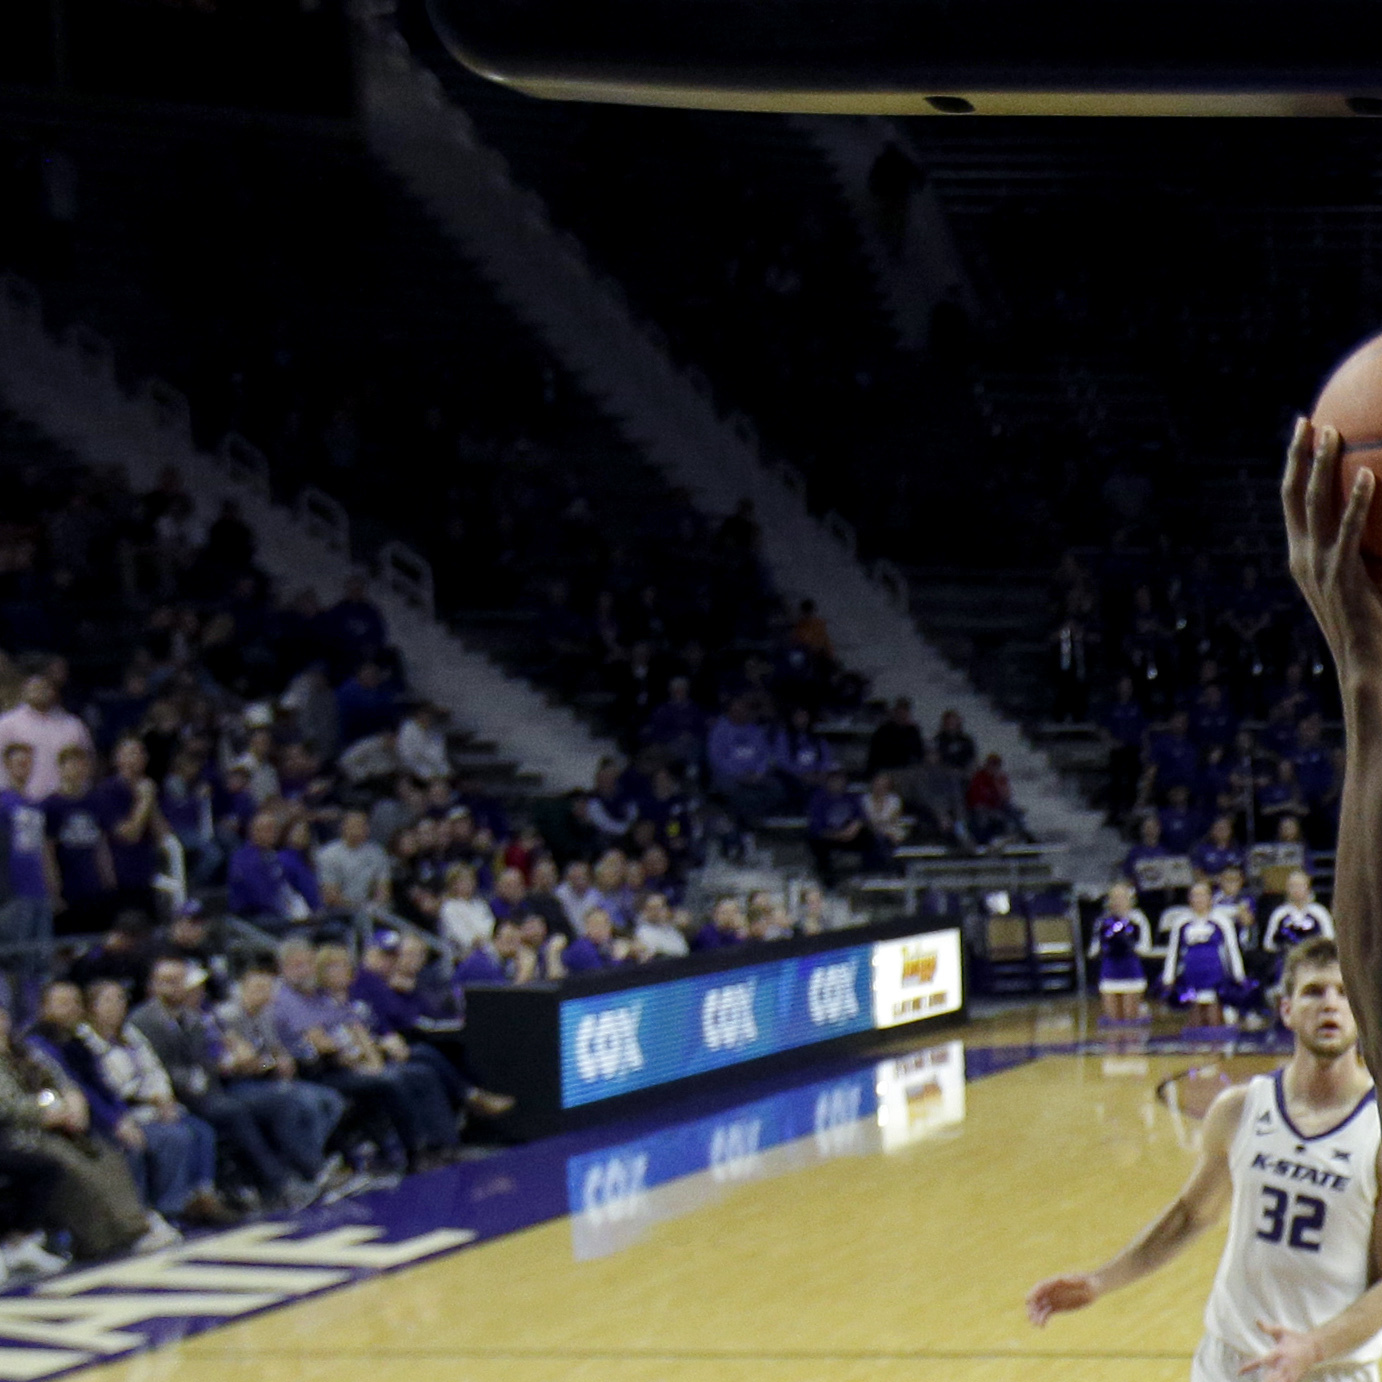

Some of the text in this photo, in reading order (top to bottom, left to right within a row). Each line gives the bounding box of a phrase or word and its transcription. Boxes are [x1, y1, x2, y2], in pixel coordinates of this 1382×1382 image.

[575, 1001, 644, 1084] COX
[1252, 1152, 1351, 1192] K-STATE
[1256, 1185, 1328, 1252] 32
